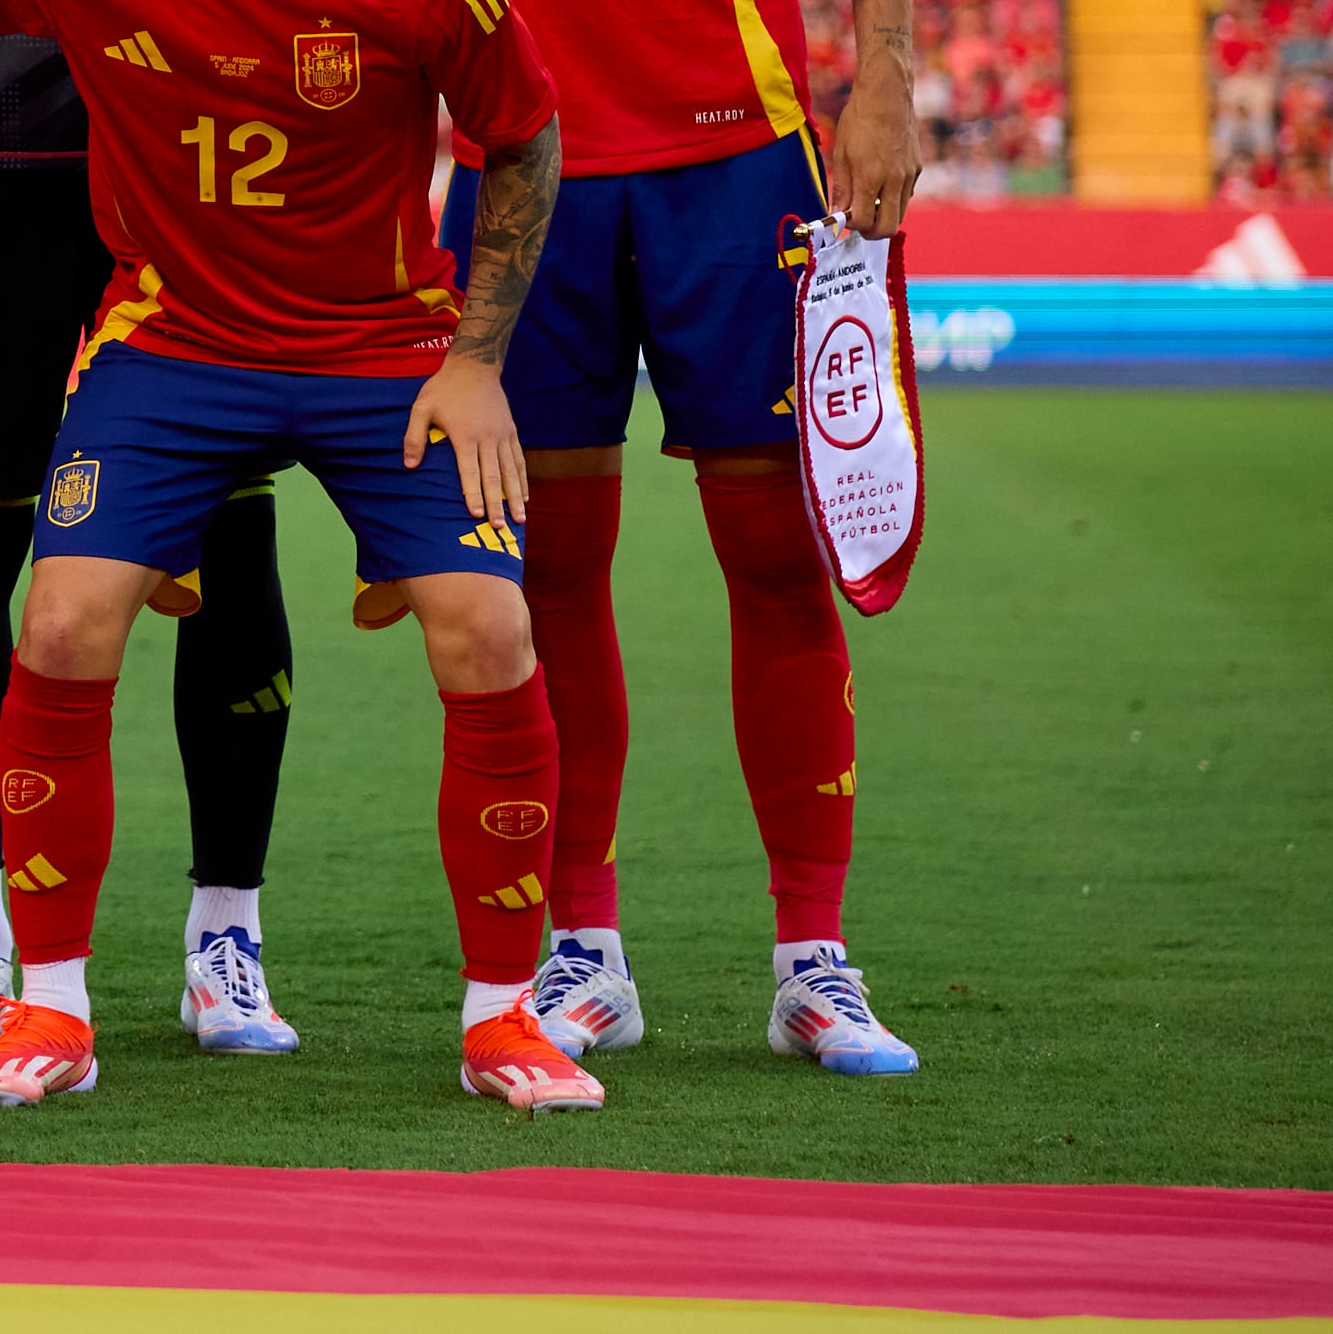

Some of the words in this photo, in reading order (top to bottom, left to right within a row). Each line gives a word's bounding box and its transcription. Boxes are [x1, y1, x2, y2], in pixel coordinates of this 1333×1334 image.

[695, 109, 745, 124] HEAT.RDY
[181, 116, 287, 206] 12
[827, 346, 863, 380] RF
[827, 384, 867, 418] EF
[837, 470, 875, 487] REAL
[822, 482, 903, 511] EDERACIÓN
[840, 522, 900, 541] FÚTBOL
[9, 778, 37, 788] RF
[8, 790, 36, 803] EF
[601, 989, 632, 1015] F50
